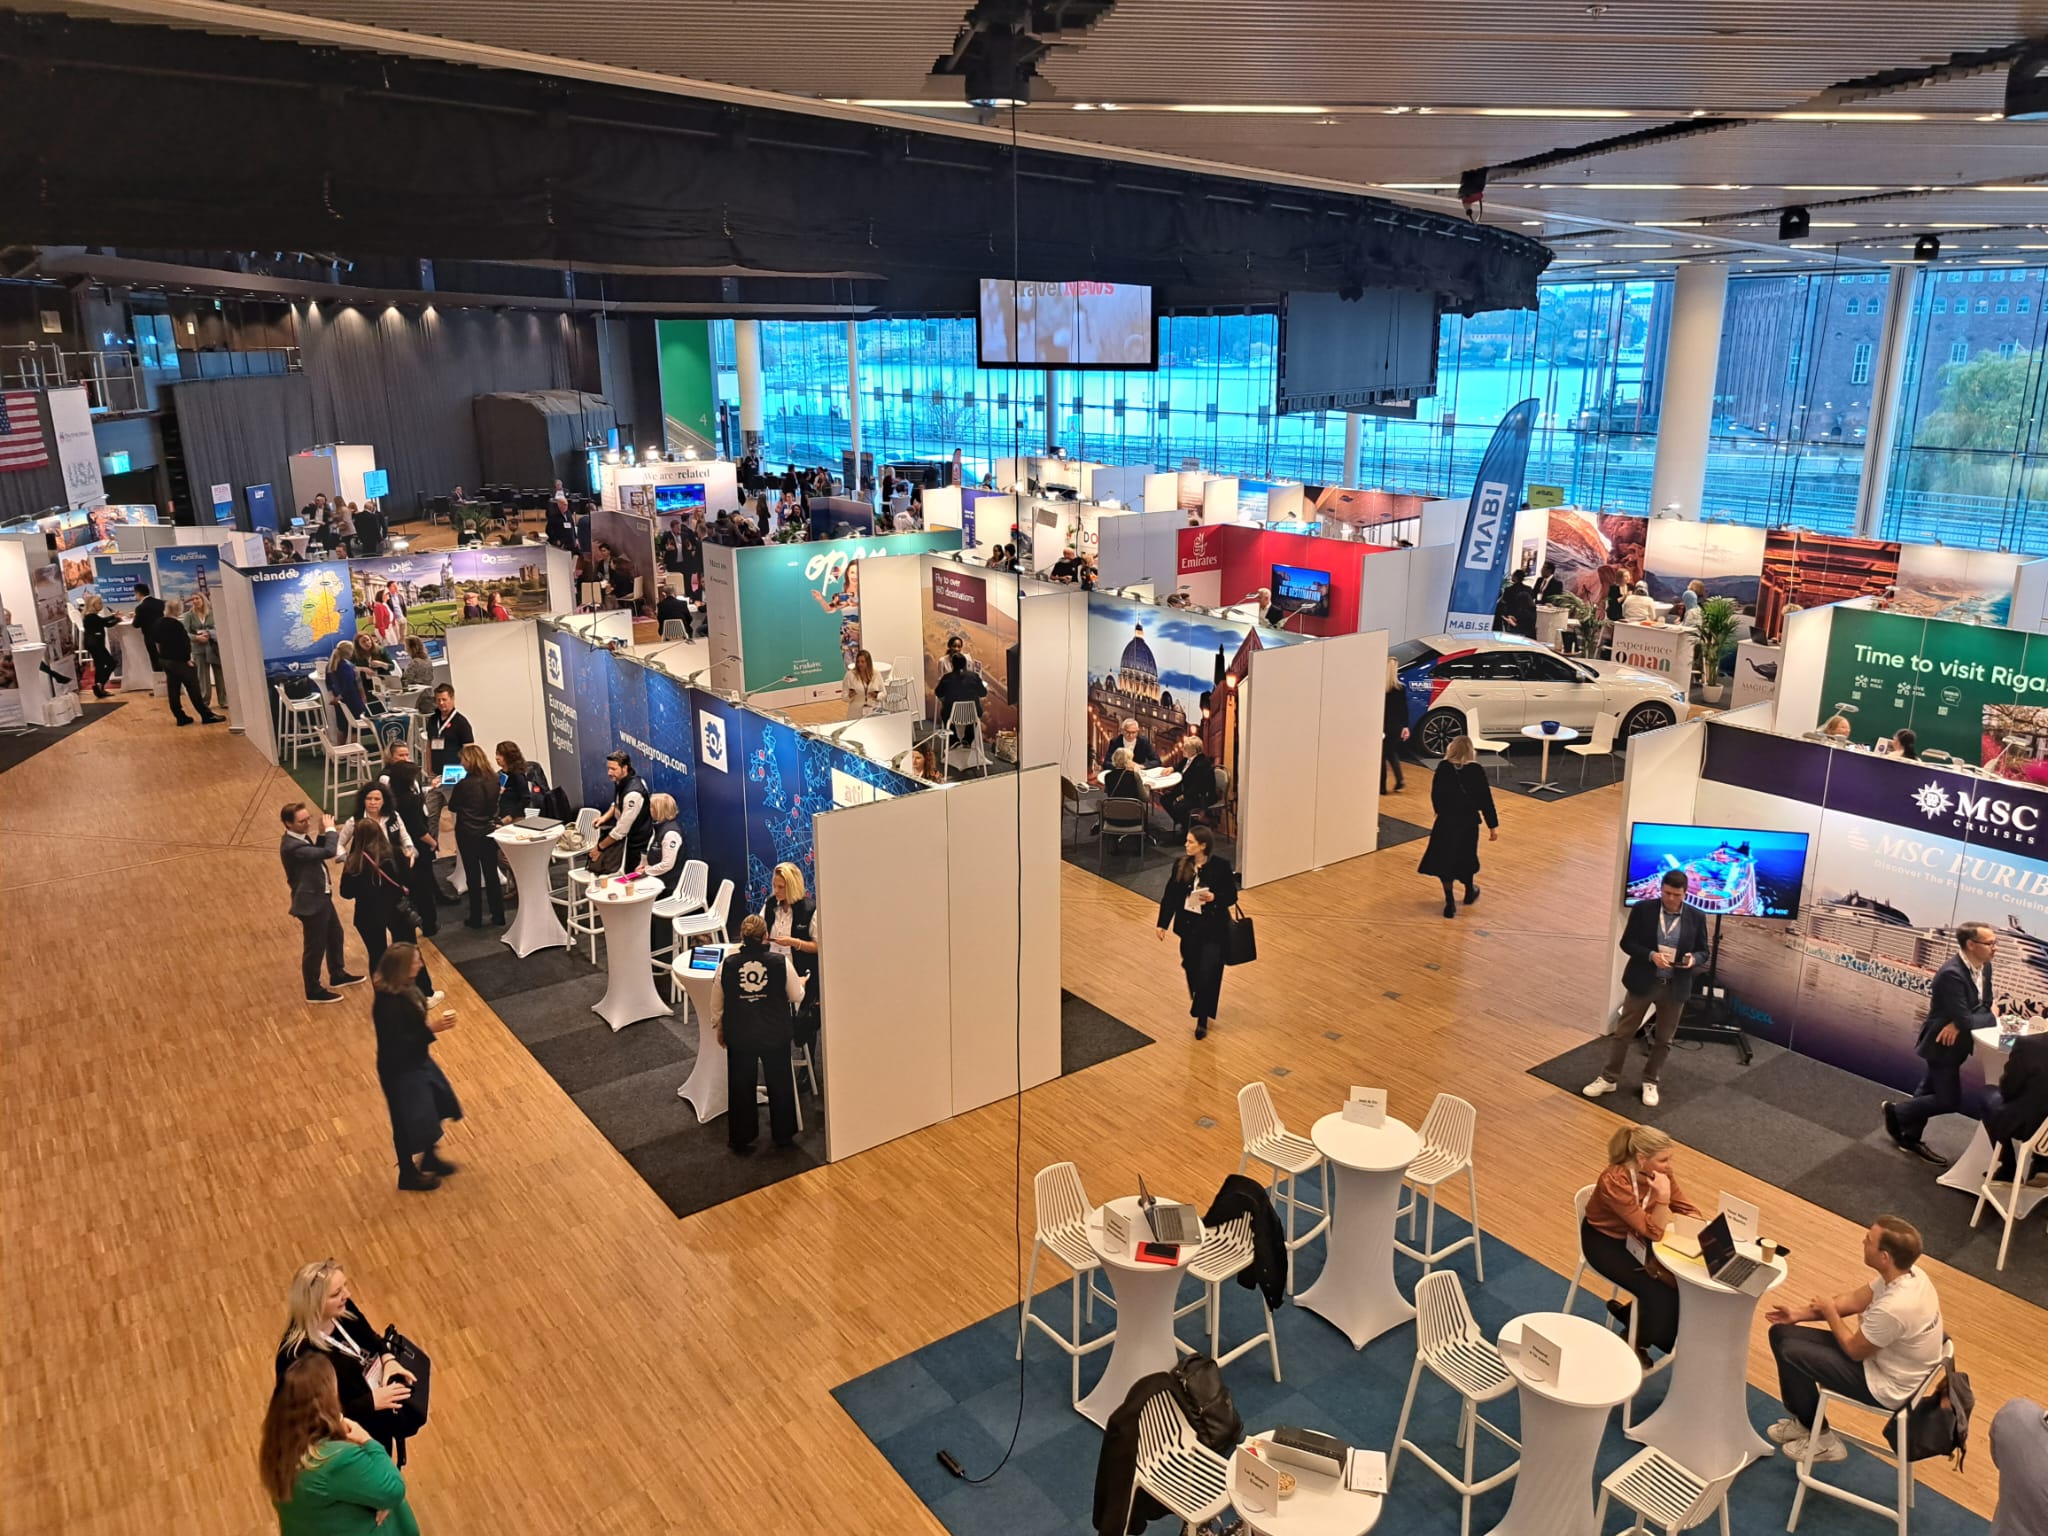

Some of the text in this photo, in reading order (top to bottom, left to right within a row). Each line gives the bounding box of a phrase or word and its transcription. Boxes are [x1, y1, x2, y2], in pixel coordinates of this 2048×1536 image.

[659, 471, 674, 479] are
[678, 468, 710, 479] related
[1470, 488, 1503, 563] MABI
[1181, 555, 1217, 569] Emirates
[935, 573, 943, 585] Fly
[950, 579, 960, 587] over
[945, 587, 975, 603] destinations
[1279, 586, 1321, 602] THE DESTINATION
[1449, 620, 1490, 631] MABI.SE
[1616, 639, 1673, 655] experience
[1615, 651, 1671, 673] oman
[1854, 644, 1905, 668] Time
[1911, 655, 1933, 673] to
[1940, 659, 1986, 682] visit
[548, 694, 578, 721] European
[551, 713, 573, 738] Quality
[552, 731, 574, 754] Agents
[619, 730, 688, 776] www.eqagroup.com
[1954, 791, 2039, 831] MSC
[1953, 819, 2035, 845] CRUISES
[1874, 835, 1945, 868] MSC
[1875, 859, 1921, 878] Discover
[1925, 872, 1944, 885] The
[1946, 879, 1984, 896] Future
[1986, 890, 1999, 899] of
